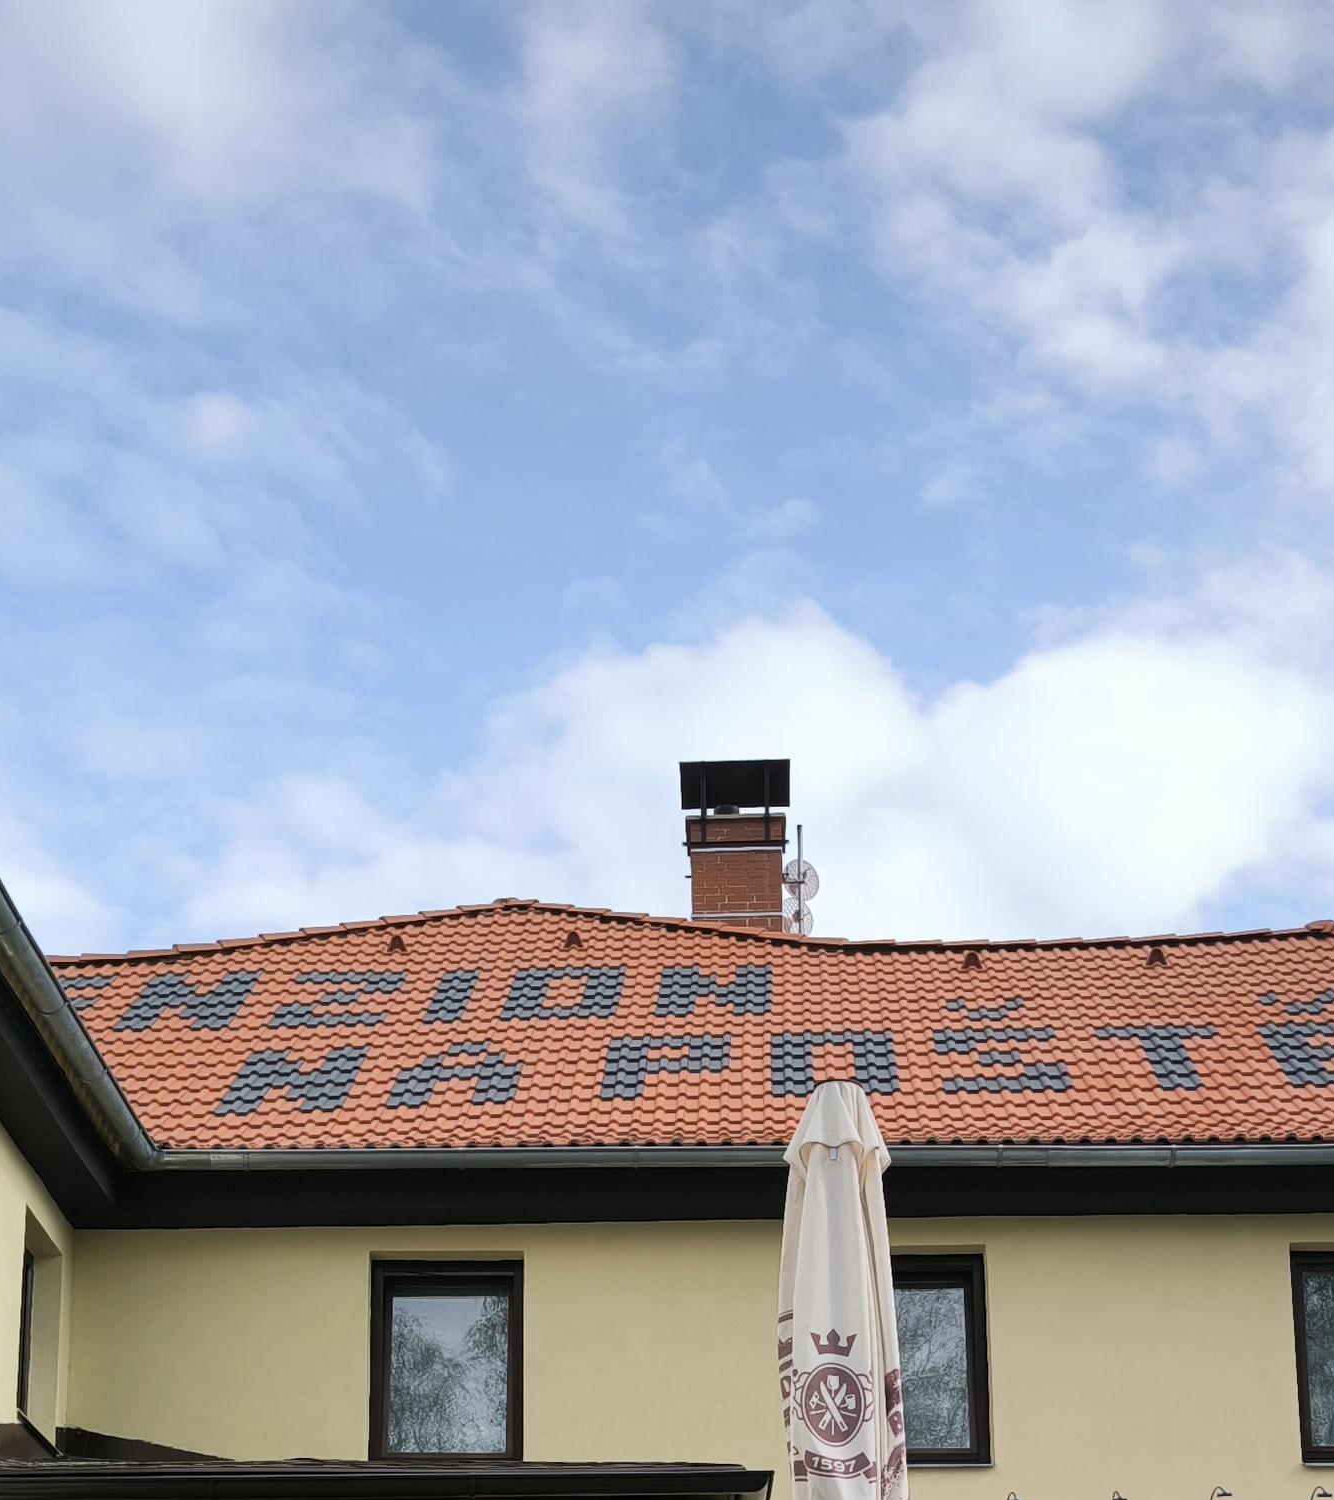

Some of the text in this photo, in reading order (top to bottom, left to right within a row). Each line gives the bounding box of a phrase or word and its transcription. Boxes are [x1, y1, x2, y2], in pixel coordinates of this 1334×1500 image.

[60, 964, 773, 1034] NZION
[212, 1042, 524, 1118] NA
[811, 1455, 857, 1473] 1597
